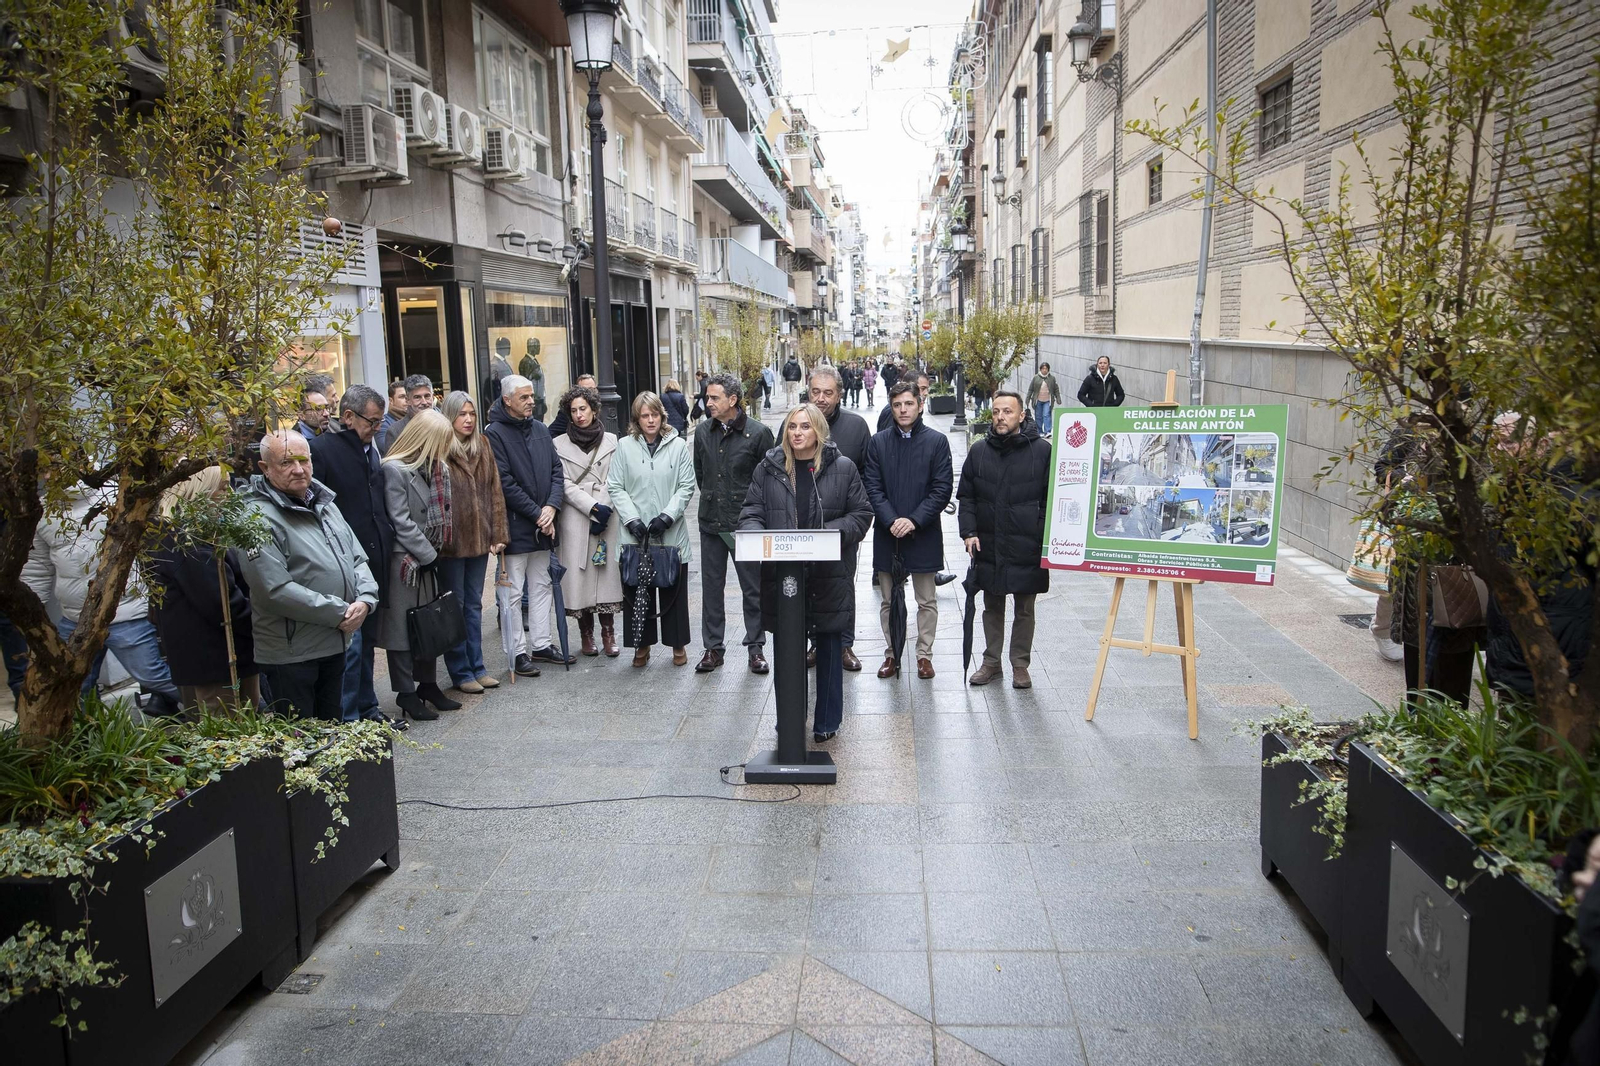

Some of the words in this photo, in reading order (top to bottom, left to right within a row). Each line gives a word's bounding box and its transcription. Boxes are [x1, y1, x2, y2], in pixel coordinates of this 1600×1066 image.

[1124, 407, 1216, 419] REMODELACIÓN
[1220, 408, 1236, 418] DE
[1240, 408, 1256, 418] LA
[1133, 421, 1170, 430] CALLE
[1173, 421, 1197, 430] SAN
[1201, 419, 1244, 430] ANTÓN
[774, 543, 793, 551] 2031
[1091, 551, 1133, 559] Contratistas:
[1090, 564, 1132, 572] Presupuesto:
